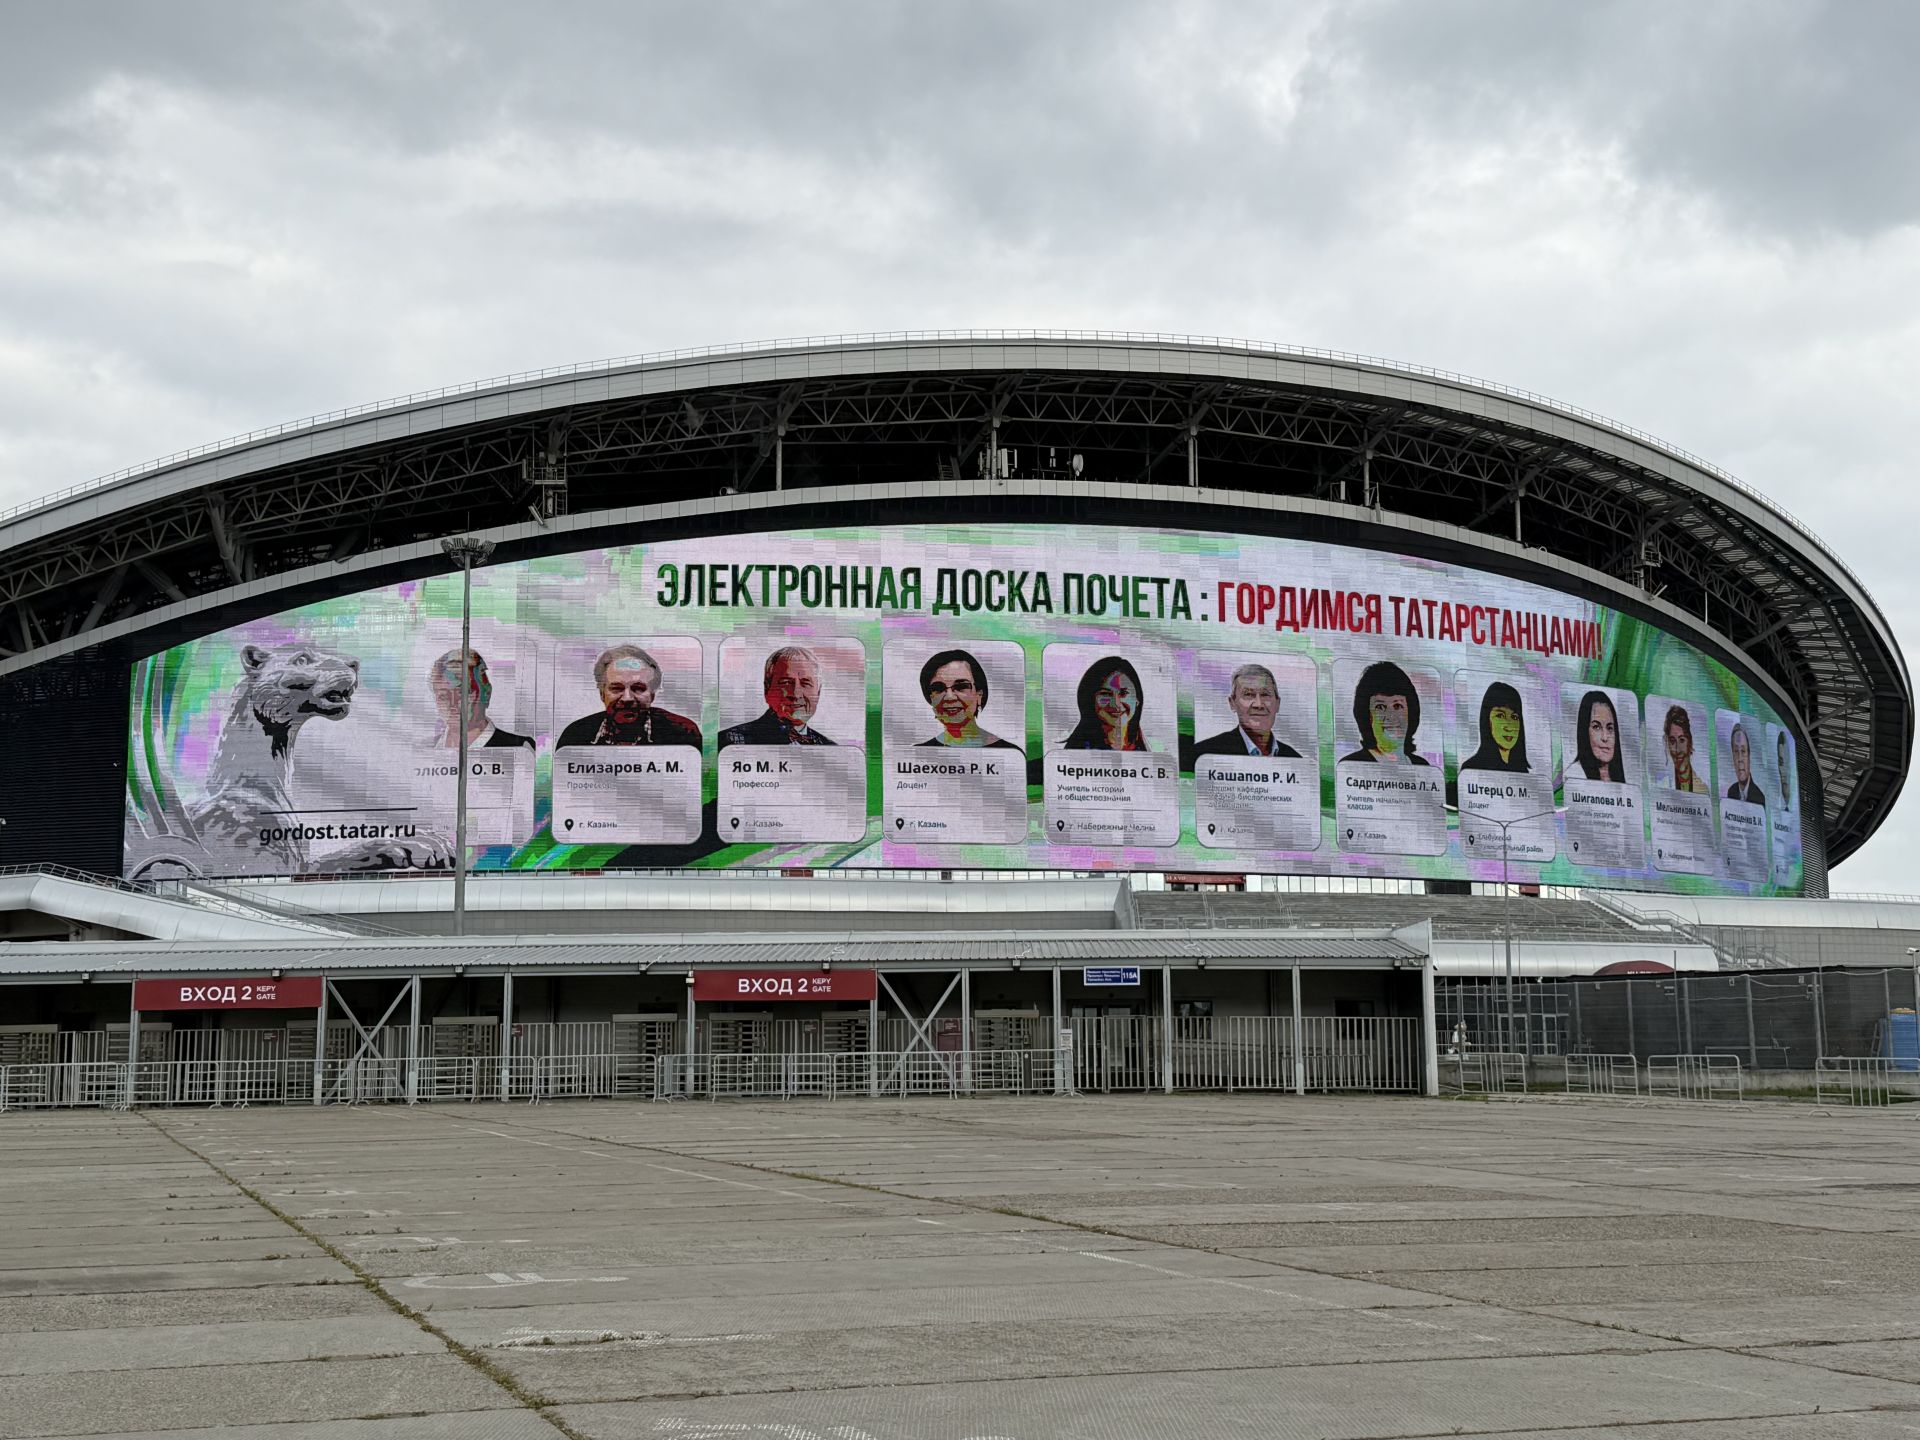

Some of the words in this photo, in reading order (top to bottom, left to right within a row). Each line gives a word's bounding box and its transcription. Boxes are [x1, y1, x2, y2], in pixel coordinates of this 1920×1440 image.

[657, 563, 922, 609] ЭЛЕКТРОННАЯ
[932, 567, 1053, 617] ДОСКА
[1217, 581, 1383, 634] ГОРДИМСЯ
[1388, 595, 1602, 661] ТАТАРСТАНЦАМИ!
[471, 763, 487, 776] О.
[492, 763, 505, 775] В.
[567, 762, 643, 777] Елизаров
[646, 761, 661, 773] А.
[665, 761, 684, 773] М.
[732, 761, 752, 773] Яо
[756, 761, 774, 773] М.
[779, 761, 793, 773] К.
[897, 762, 966, 775] Шаехова
[970, 763, 982, 775] Р.
[986, 763, 999, 775] К.
[1056, 764, 1137, 780] Черникова
[1141, 767, 1154, 779] С.
[1157, 768, 1169, 779] В.
[1208, 769, 1269, 783] Кашапов
[1272, 772, 1283, 784] Р.
[1286, 773, 1300, 784] И.
[732, 780, 780, 790] Профессор
[896, 781, 928, 790] Доцент
[1057, 784, 1090, 793] Учитель
[1346, 776, 1416, 791] Садртдинова
[1419, 781, 1429, 791] Л.
[1430, 782, 1440, 792] А.
[1467, 783, 1504, 799] Штерц
[1505, 786, 1516, 798] О.
[1518, 787, 1531, 798] М.
[1572, 792, 1615, 806] Шигапова
[1616, 797, 1625, 807] И.
[1626, 798, 1634, 808] В.
[587, 820, 618, 829] Казань
[753, 820, 784, 828] Казань
[917, 820, 948, 829] Казань
[259, 823, 416, 846] gordost.tatar.ru
[738, 978, 793, 996] ВХОД
[797, 978, 808, 993] 2
[812, 985, 832, 993] GATE
[180, 986, 237, 1004] ВХОД
[241, 985, 252, 1000] 2
